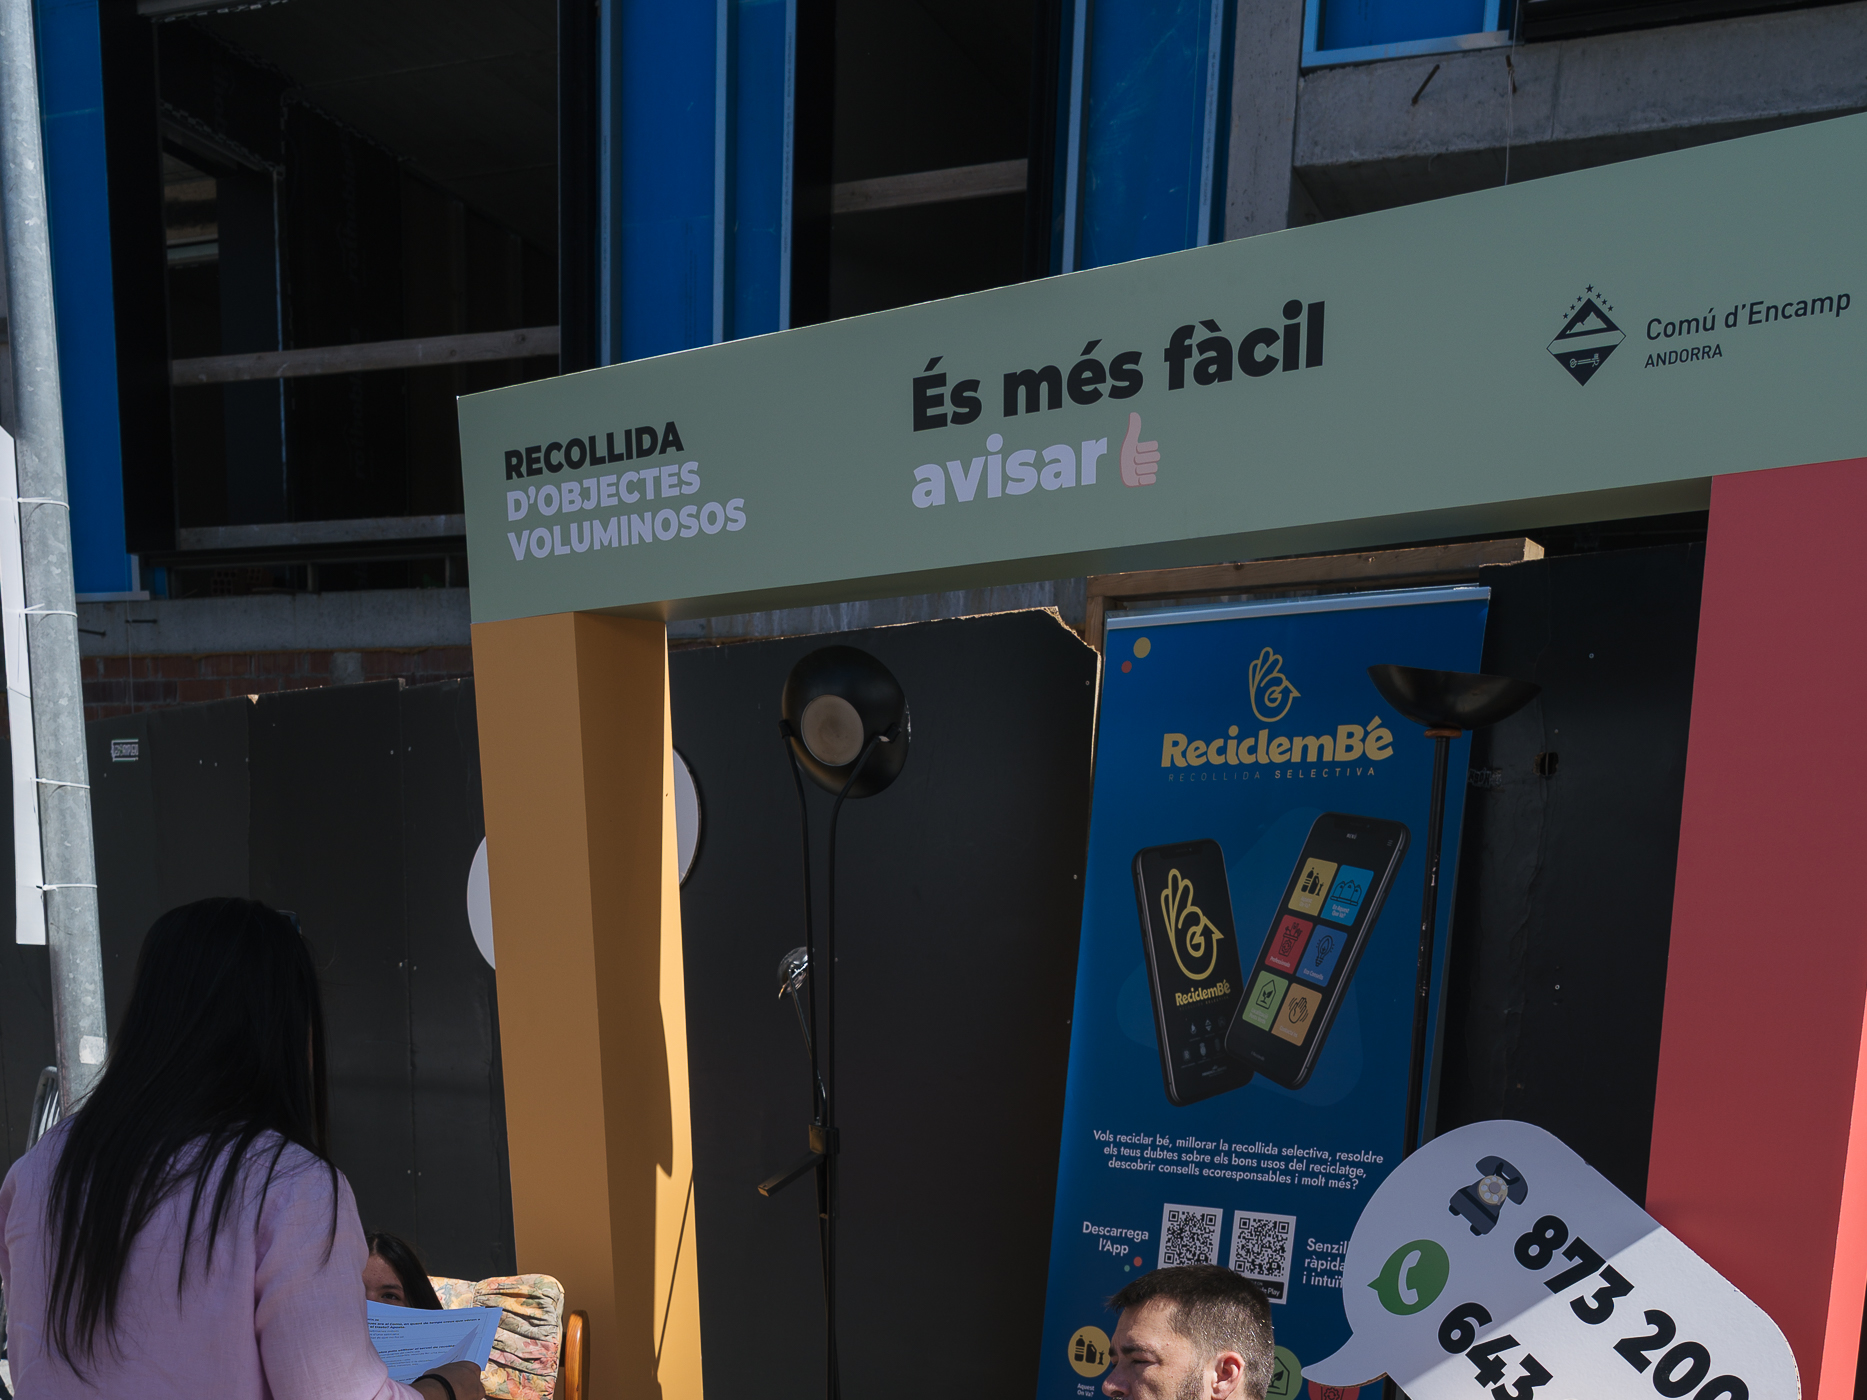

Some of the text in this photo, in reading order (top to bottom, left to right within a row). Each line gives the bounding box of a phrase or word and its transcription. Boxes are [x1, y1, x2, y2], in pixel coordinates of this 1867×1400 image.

[1645, 292, 1851, 341] Comú d'Encamp
[911, 299, 1326, 432] És més fàcil
[1644, 343, 1723, 369] ANDORRA
[503, 419, 685, 482] RECOLLIDA
[911, 431, 1110, 510] avisar
[505, 461, 702, 523] D'OBJECTES
[507, 497, 748, 562] VOLUMINOSOS
[1161, 715, 1395, 768] ReciclemBé
[1168, 766, 1376, 783] RECOLLIDA SELECTIVA
[1175, 979, 1231, 1006] ReciclemBé
[1093, 1129, 1384, 1164] Vols reciclar bé, millorar la recollida selectiva, resoldre
[1103, 1143, 1368, 1179] els teus dubtes sobre els bons usos del reciclatge,
[1108, 1156, 1360, 1190] descobrir consells ecoresponsables i molt més?
[1082, 1220, 1150, 1243] Descarrega
[1098, 1237, 1130, 1258] l'App
[1302, 1271, 1308, 1285] i
[1513, 1213, 1636, 1327] 873
[1077, 1383, 1095, 1392] Aquest
[1085, 1390, 1094, 1398] Va?
